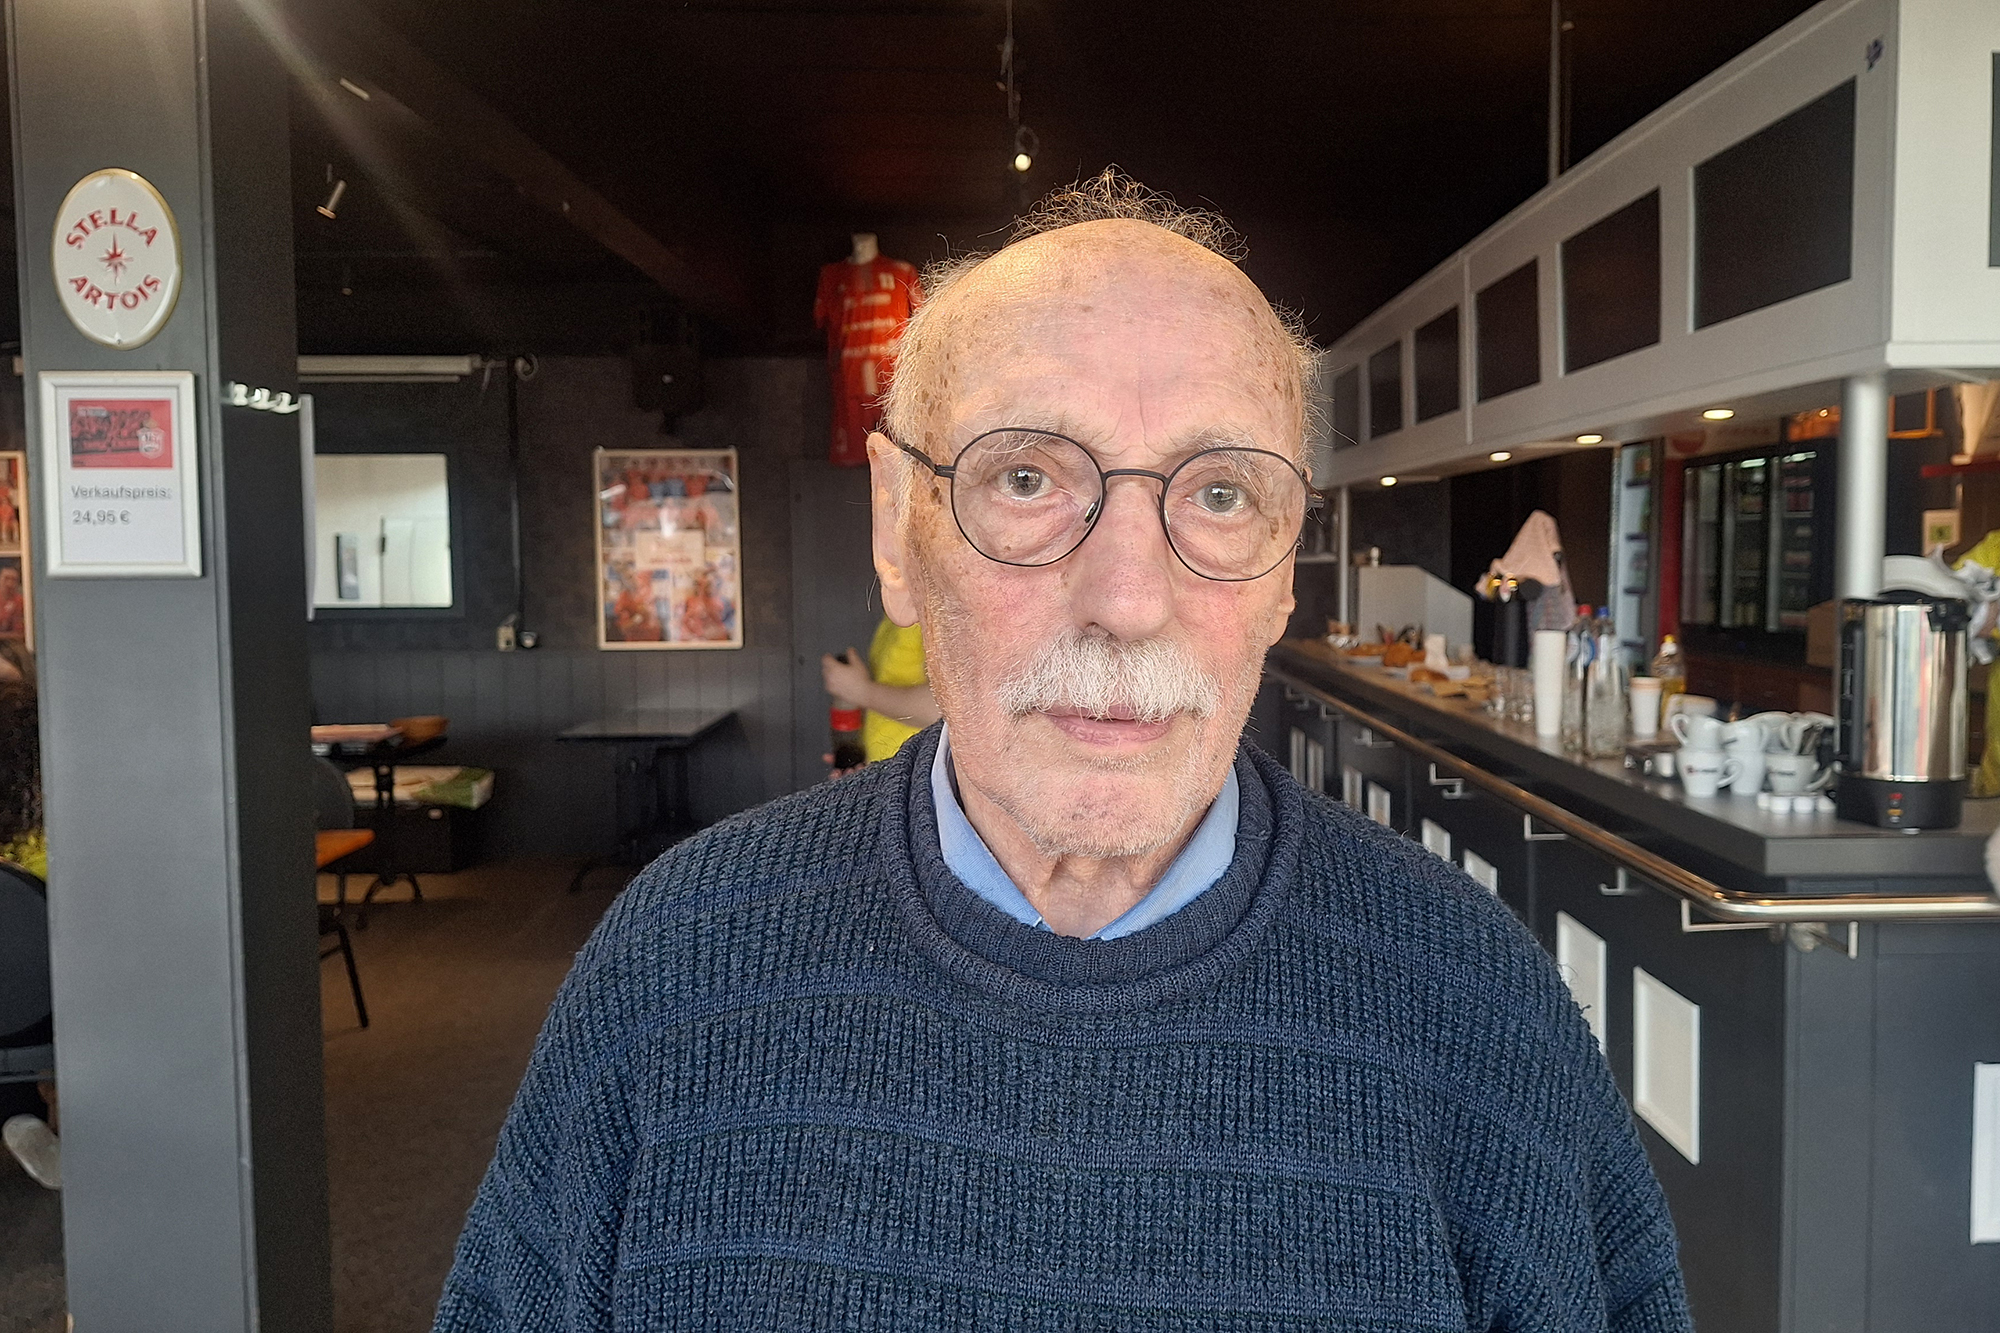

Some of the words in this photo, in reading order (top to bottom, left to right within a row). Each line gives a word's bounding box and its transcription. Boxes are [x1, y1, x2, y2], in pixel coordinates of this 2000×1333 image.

[66, 207, 158, 249] STELLA
[69, 274, 161, 310] ARTOIS
[71, 485, 172, 500] Verkaufspreis:
[72, 509, 116, 525] 24,95
[120, 509, 131, 524] €
